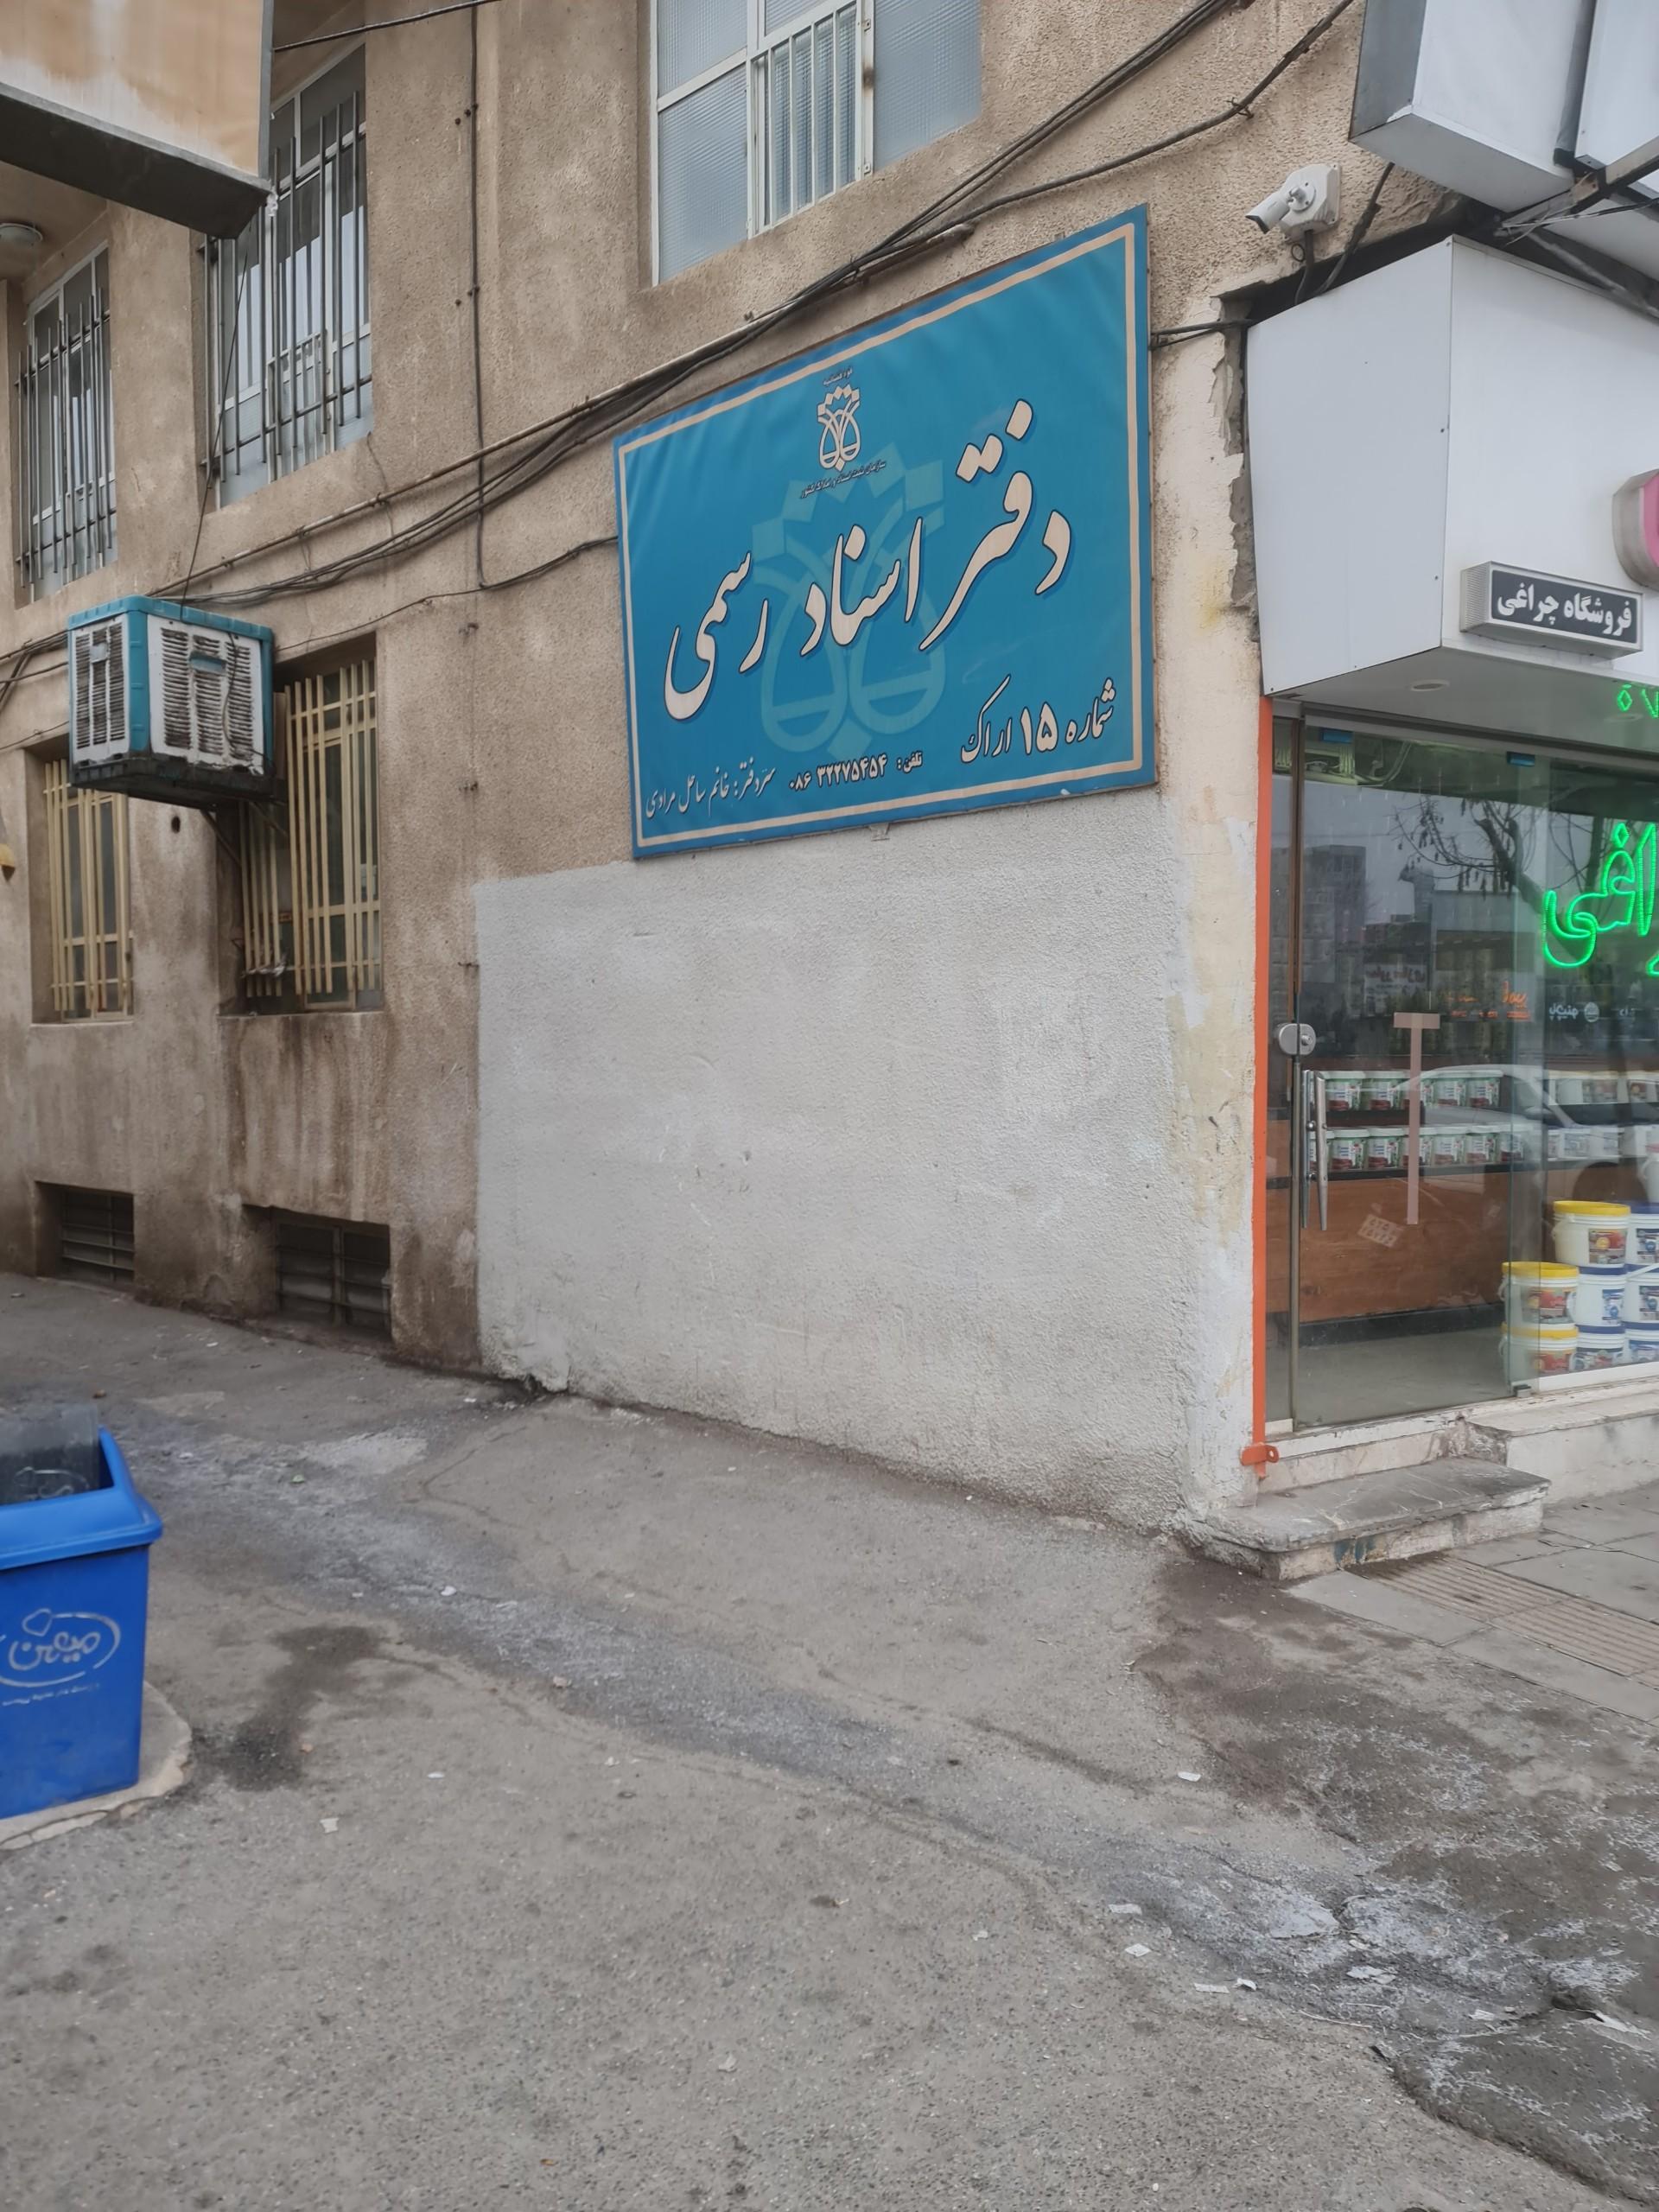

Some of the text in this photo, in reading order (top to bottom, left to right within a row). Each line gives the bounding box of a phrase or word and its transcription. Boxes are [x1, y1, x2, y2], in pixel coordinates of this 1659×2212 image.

[663, 398, 1072, 721] دفتر اسناد رسمی
[1497, 582, 1632, 636] فروشگاه چراغی
[960, 674, 1117, 763] شماره ۱۵ اراک
[789, 771, 812, 791] ۰۸۶
[817, 753, 888, 787] ۳۲۲۷۵۴۵۴
[645, 787, 676, 818] مرادی
[8, 1630, 102, 1671] میهن
